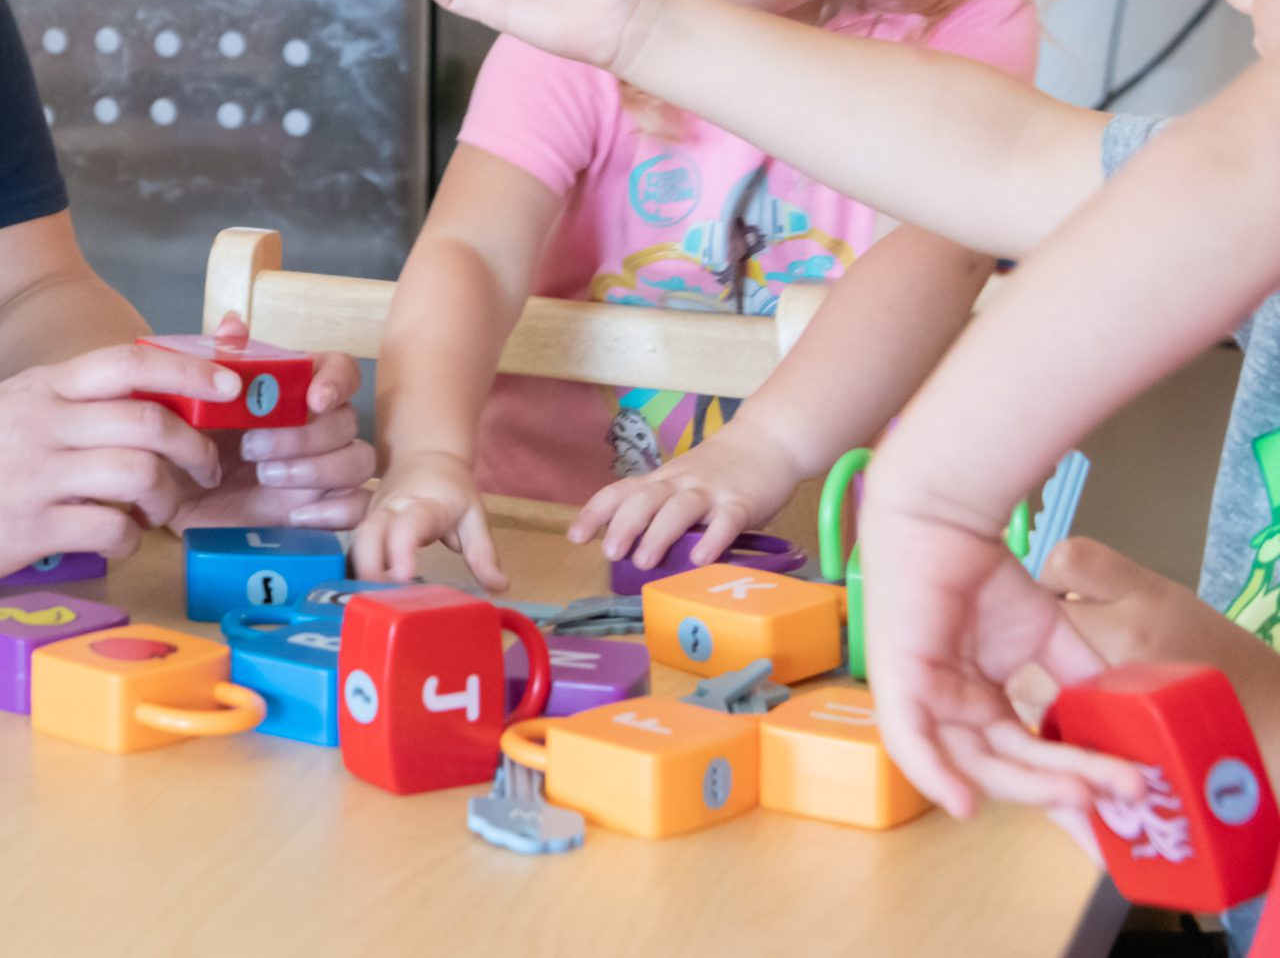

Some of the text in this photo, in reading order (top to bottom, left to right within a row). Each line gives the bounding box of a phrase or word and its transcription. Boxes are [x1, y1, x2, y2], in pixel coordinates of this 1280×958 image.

[245, 532, 281, 548] L
[707, 577, 778, 599] K
[421, 674, 481, 722] J
[611, 711, 672, 735] F
